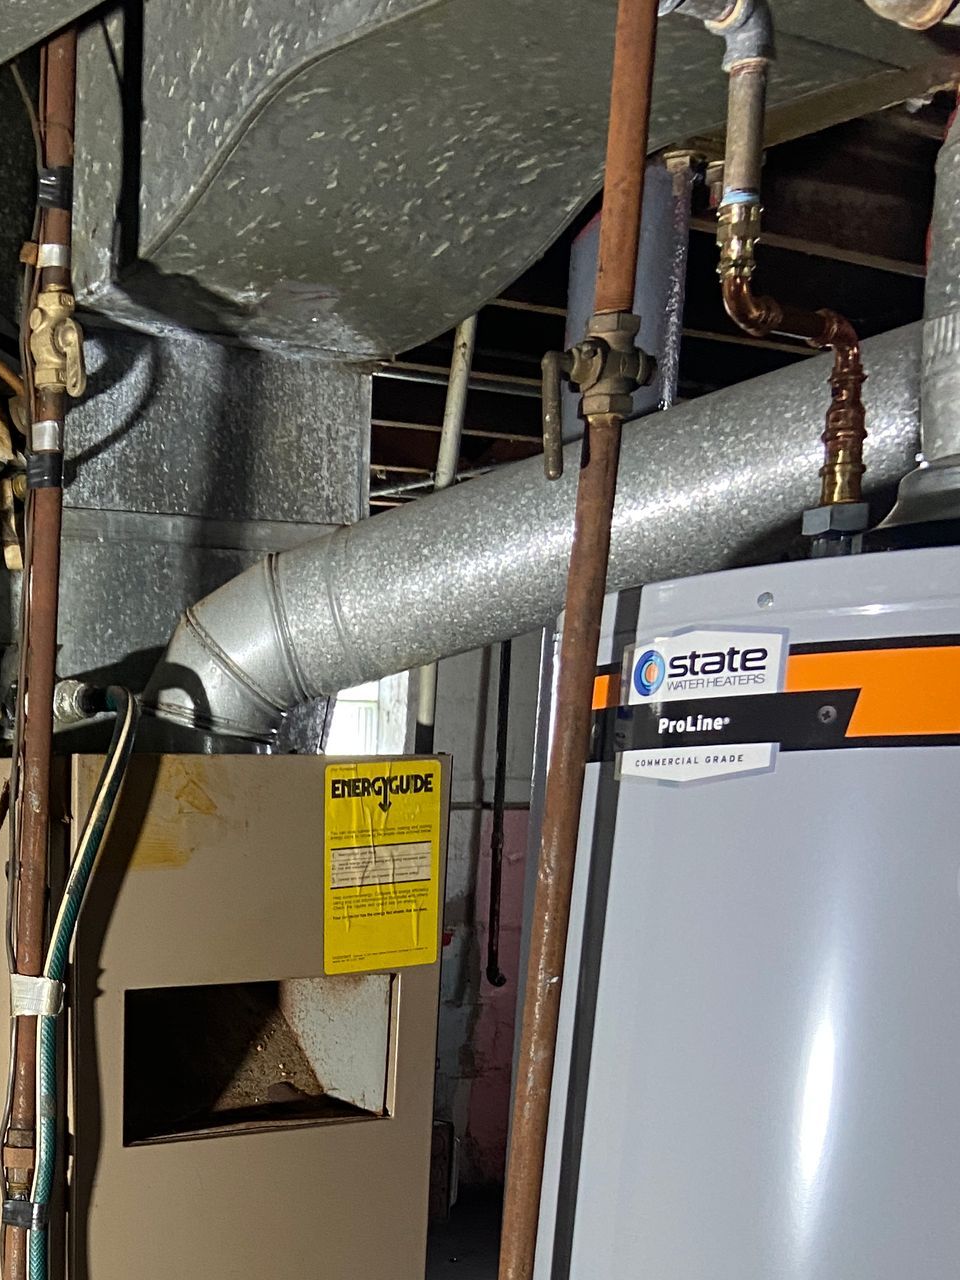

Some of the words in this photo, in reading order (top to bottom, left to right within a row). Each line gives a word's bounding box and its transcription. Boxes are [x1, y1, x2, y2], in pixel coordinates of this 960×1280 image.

[667, 648, 768, 678] state
[667, 677, 705, 692] WATER
[705, 673, 765, 687] HEATERS
[635, 756, 699, 767] COMMERCIAL
[705, 754, 744, 764] GRADE
[331, 773, 433, 799] ENERGYGUIDE
